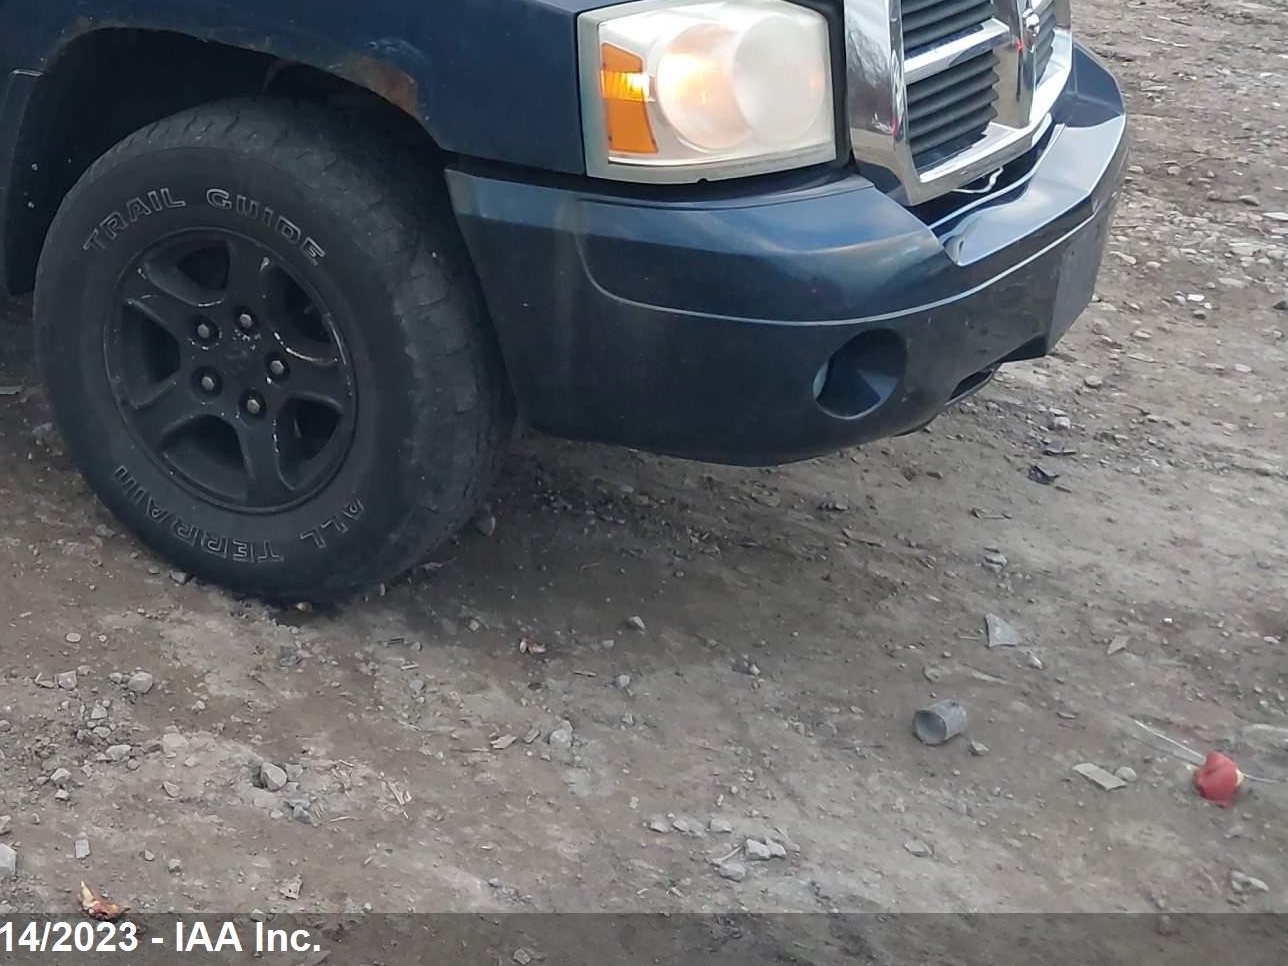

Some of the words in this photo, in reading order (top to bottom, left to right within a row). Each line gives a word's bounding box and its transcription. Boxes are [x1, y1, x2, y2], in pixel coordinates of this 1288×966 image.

[82, 187, 187, 252] TRAIL
[206, 188, 326, 267] GUIDE
[114, 465, 285, 564] TERRAIN
[299, 497, 365, 550] ALL
